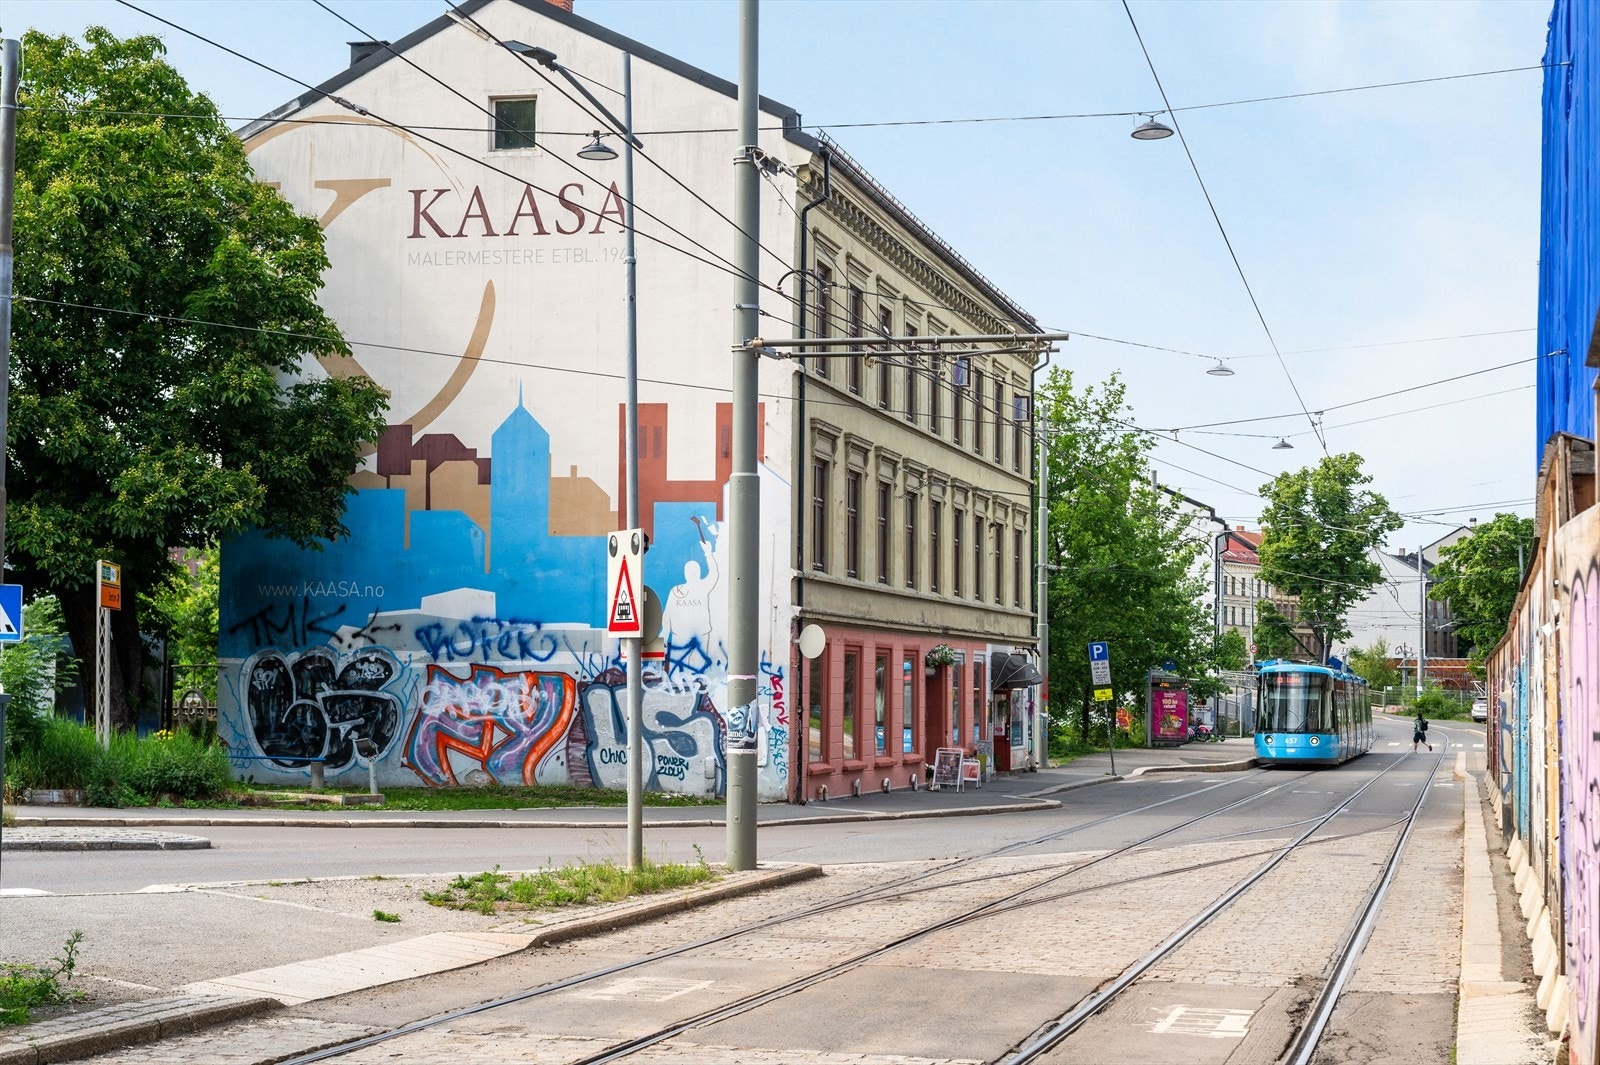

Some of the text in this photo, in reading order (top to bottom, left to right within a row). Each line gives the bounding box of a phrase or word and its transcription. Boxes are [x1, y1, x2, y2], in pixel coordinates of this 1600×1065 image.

[407, 180, 625, 238] KAASA
[408, 248, 545, 266] MALERMESTERE
[257, 580, 385, 598] www.KAASA.no
[1092, 644, 1103, 659] P
